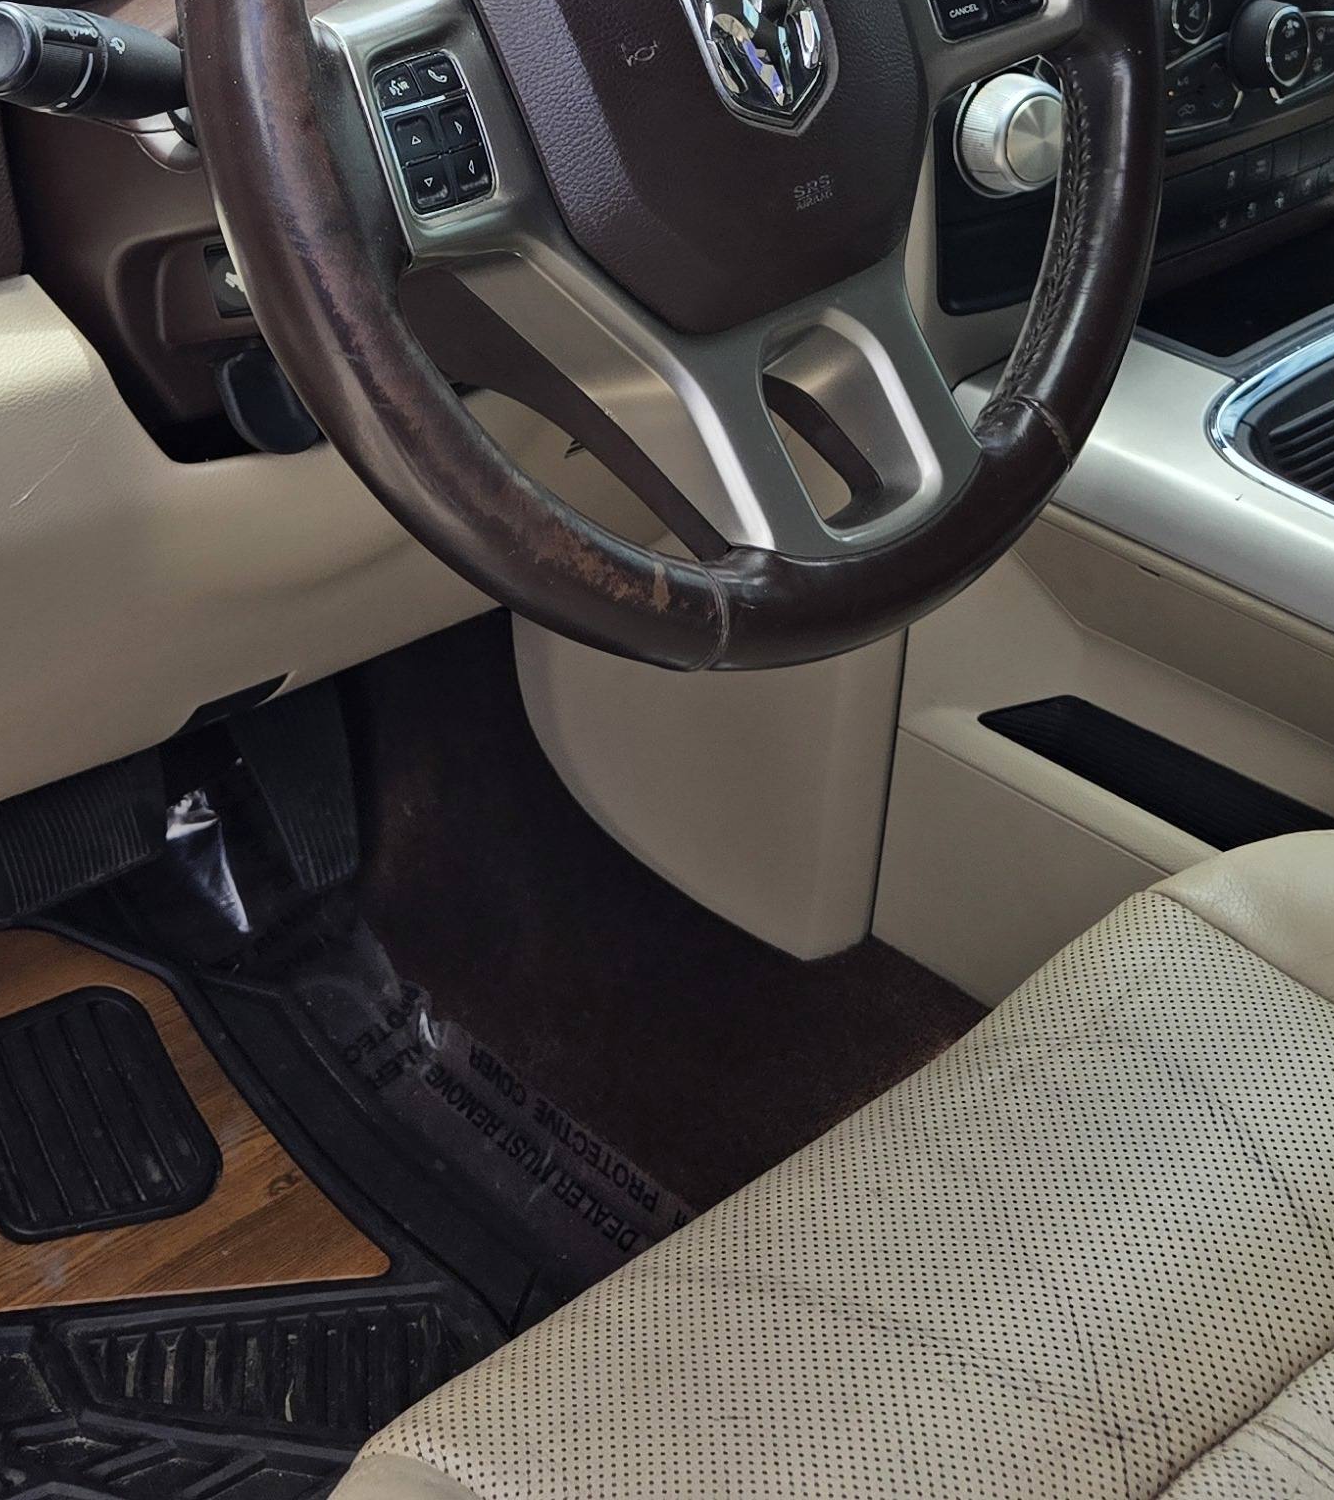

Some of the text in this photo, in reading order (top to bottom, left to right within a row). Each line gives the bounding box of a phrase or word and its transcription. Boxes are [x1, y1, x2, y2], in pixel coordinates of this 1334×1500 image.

[949, 3, 979, 19] CANCEL
[425, 1060, 639, 1253] DEALER MUST REMOVE
[469, 1043, 659, 1212] PROTECTIVE COVER
